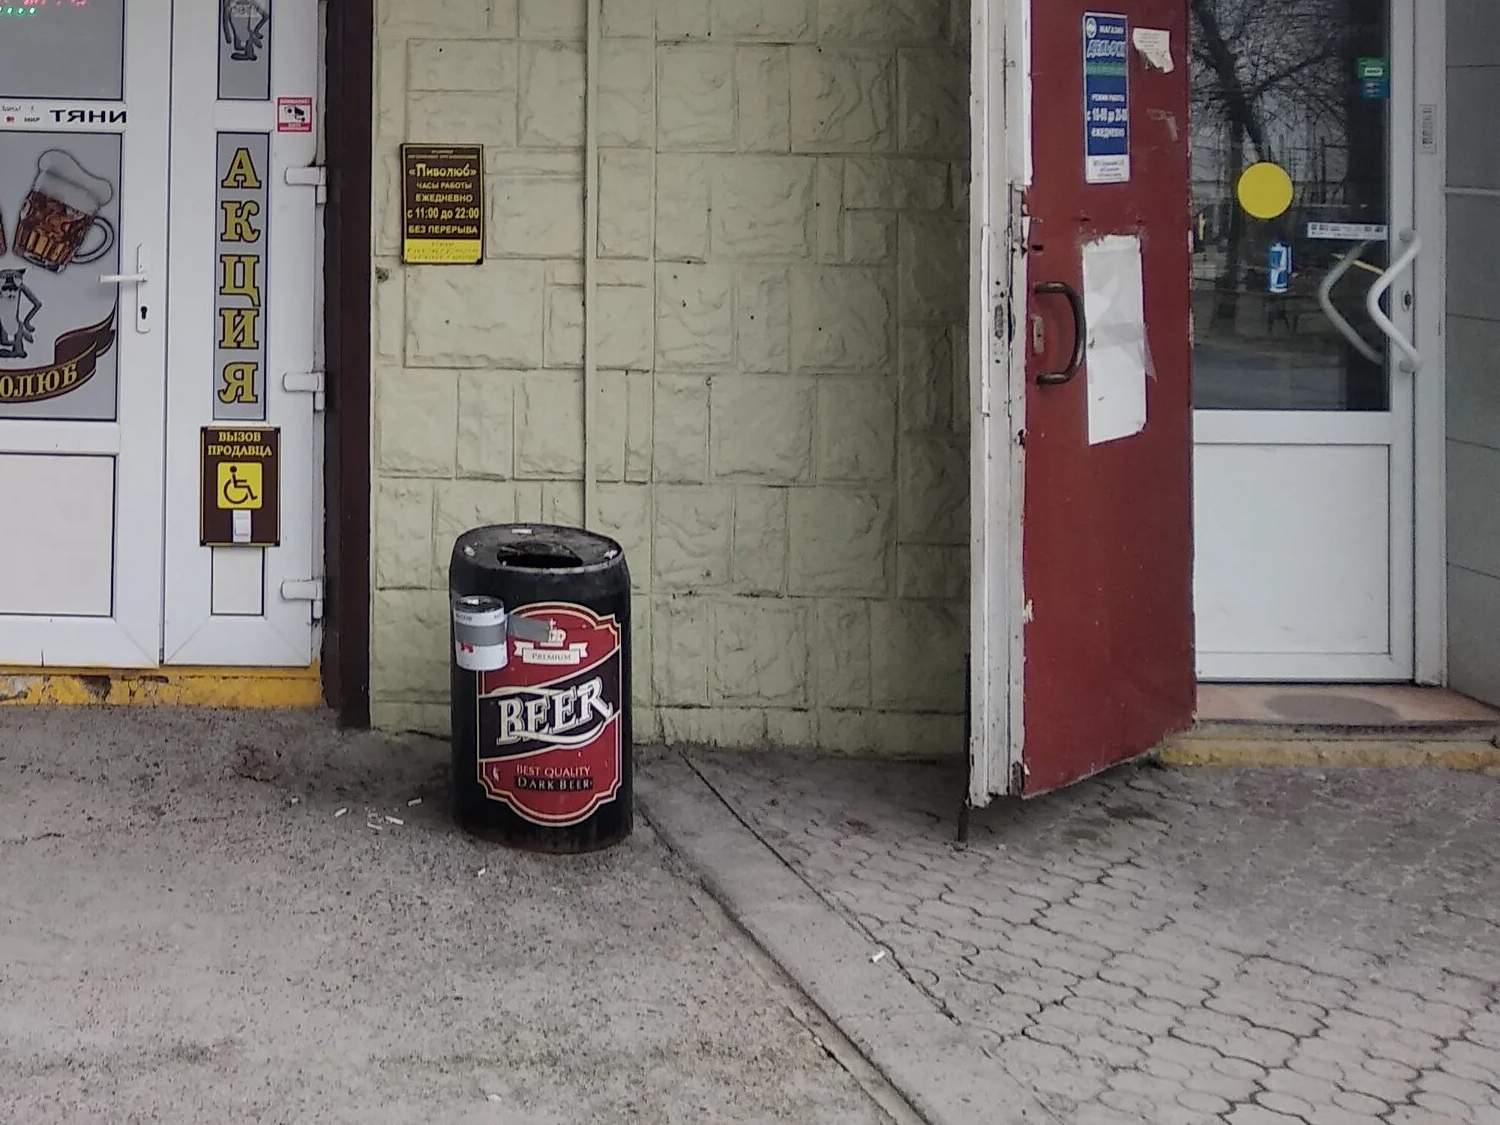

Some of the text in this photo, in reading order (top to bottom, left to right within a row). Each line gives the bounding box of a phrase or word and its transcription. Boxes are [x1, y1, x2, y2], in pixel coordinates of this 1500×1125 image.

[49, 109, 127, 123] ТЯНИ
[415, 194, 473, 202] ЕЖЕДНЕВНО
[415, 207, 438, 218] 11:00
[441, 209, 453, 220] до
[455, 207, 479, 219] 22:00
[408, 225, 478, 234] БЕЗ ПЕРЕРЫВА
[219, 432, 261, 442] ВЫЗОВ
[208, 445, 273, 458] ПРОДАВЦА
[532, 652, 571, 661] PREMIUM
[496, 676, 613, 745] BEER
[516, 764, 591, 778] BEST QUALITY
[518, 776, 554, 790] DARK
